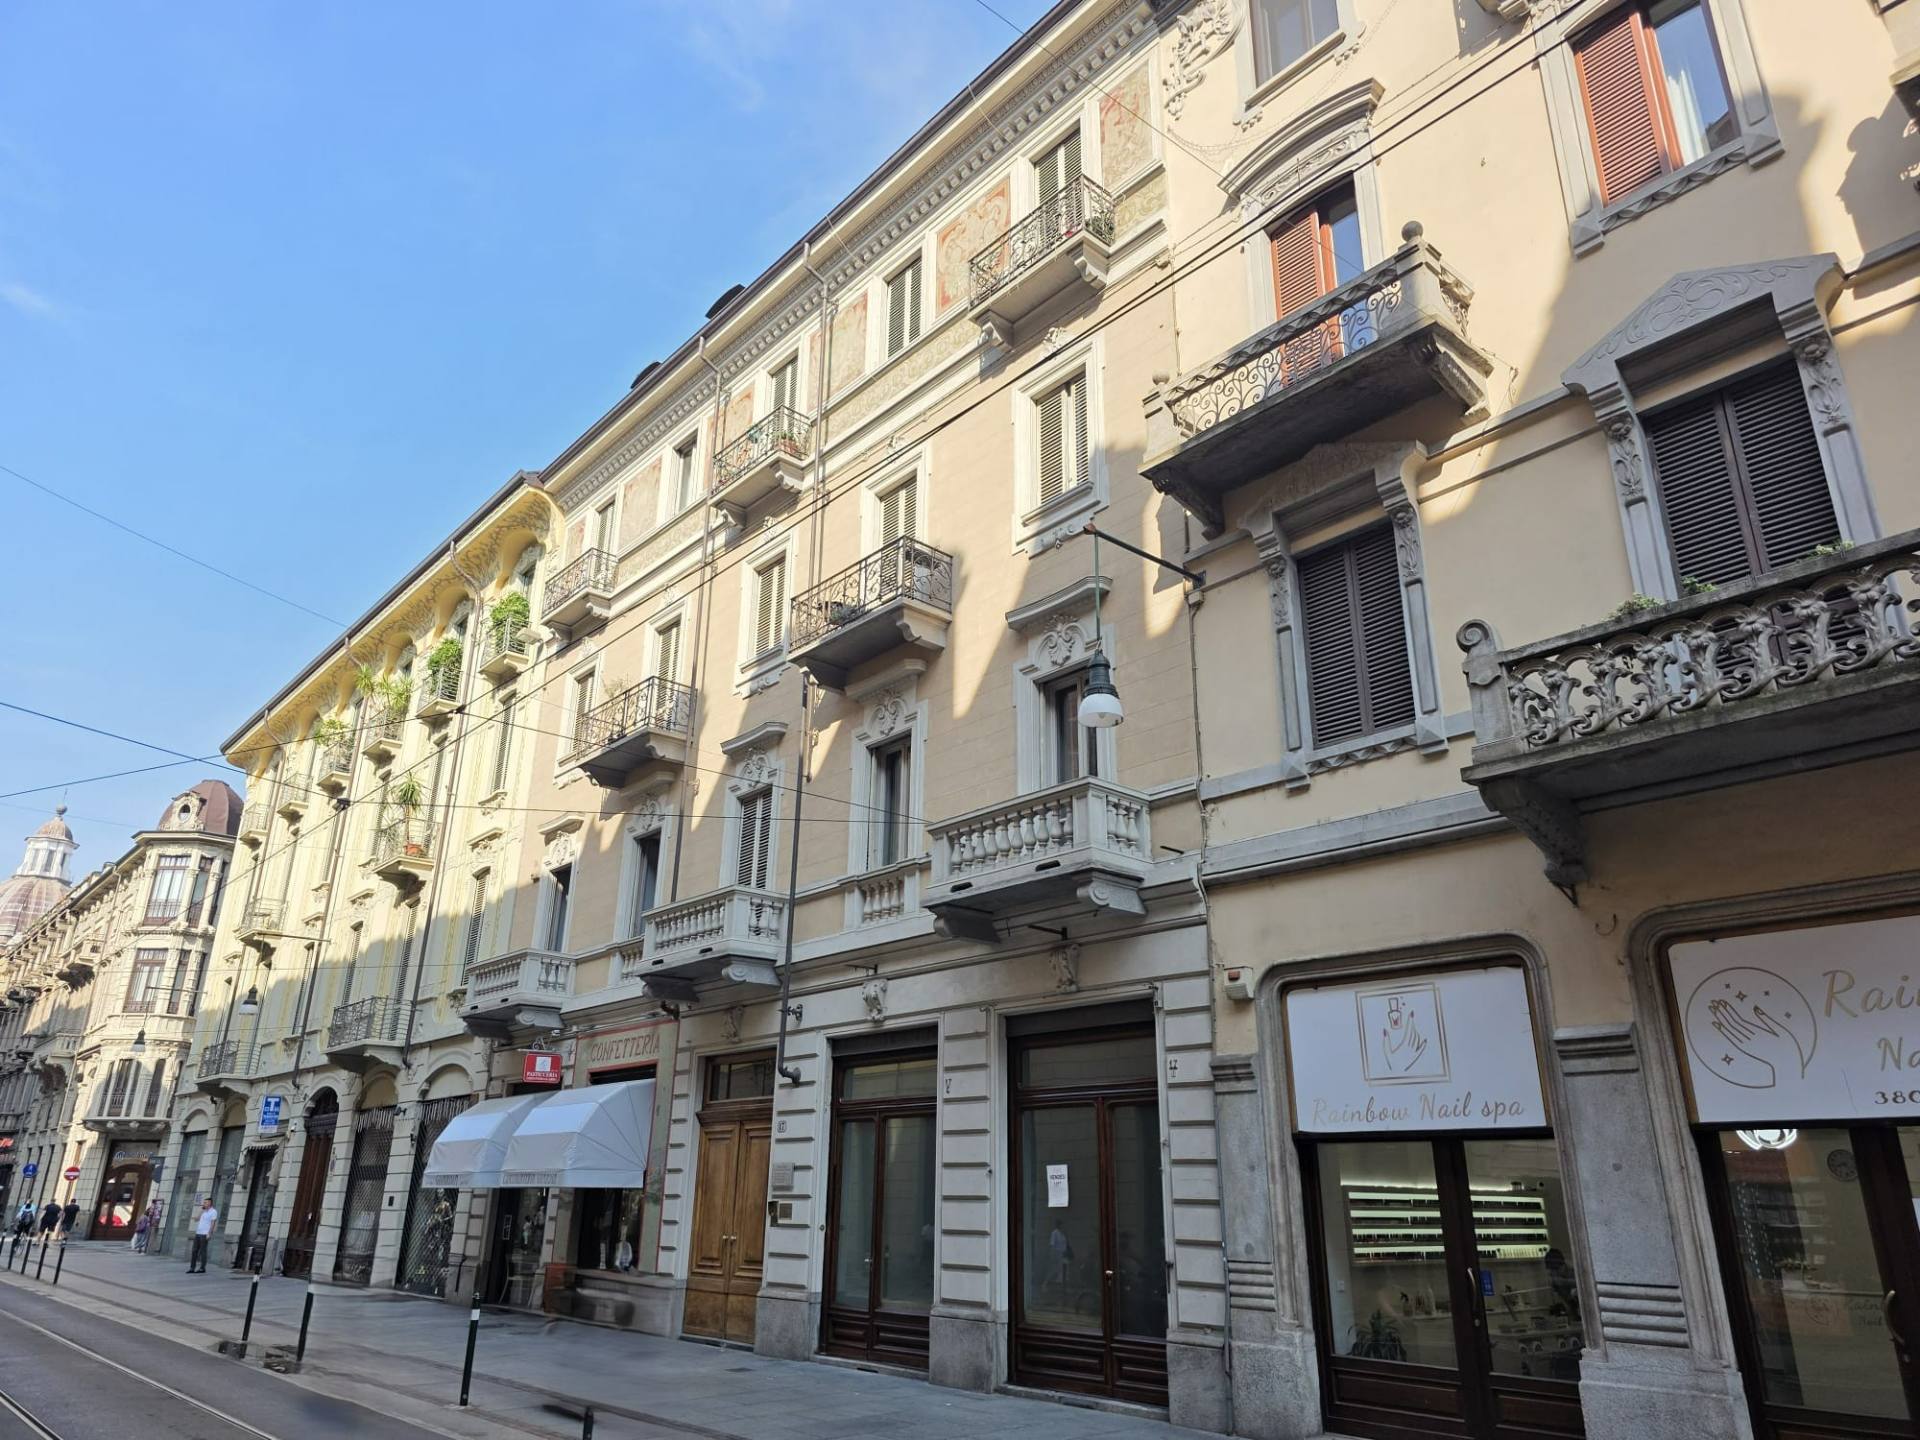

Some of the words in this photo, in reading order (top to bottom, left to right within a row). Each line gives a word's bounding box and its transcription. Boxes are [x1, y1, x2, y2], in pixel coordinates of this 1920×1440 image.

[1822, 969, 1920, 1018] Rai
[591, 1032, 660, 1061] CONFETTERIA
[267, 1097, 280, 1111] T
[1311, 1096, 1410, 1126] Rainbow
[1420, 1091, 1472, 1122] Nail
[1481, 1096, 1524, 1124] spa
